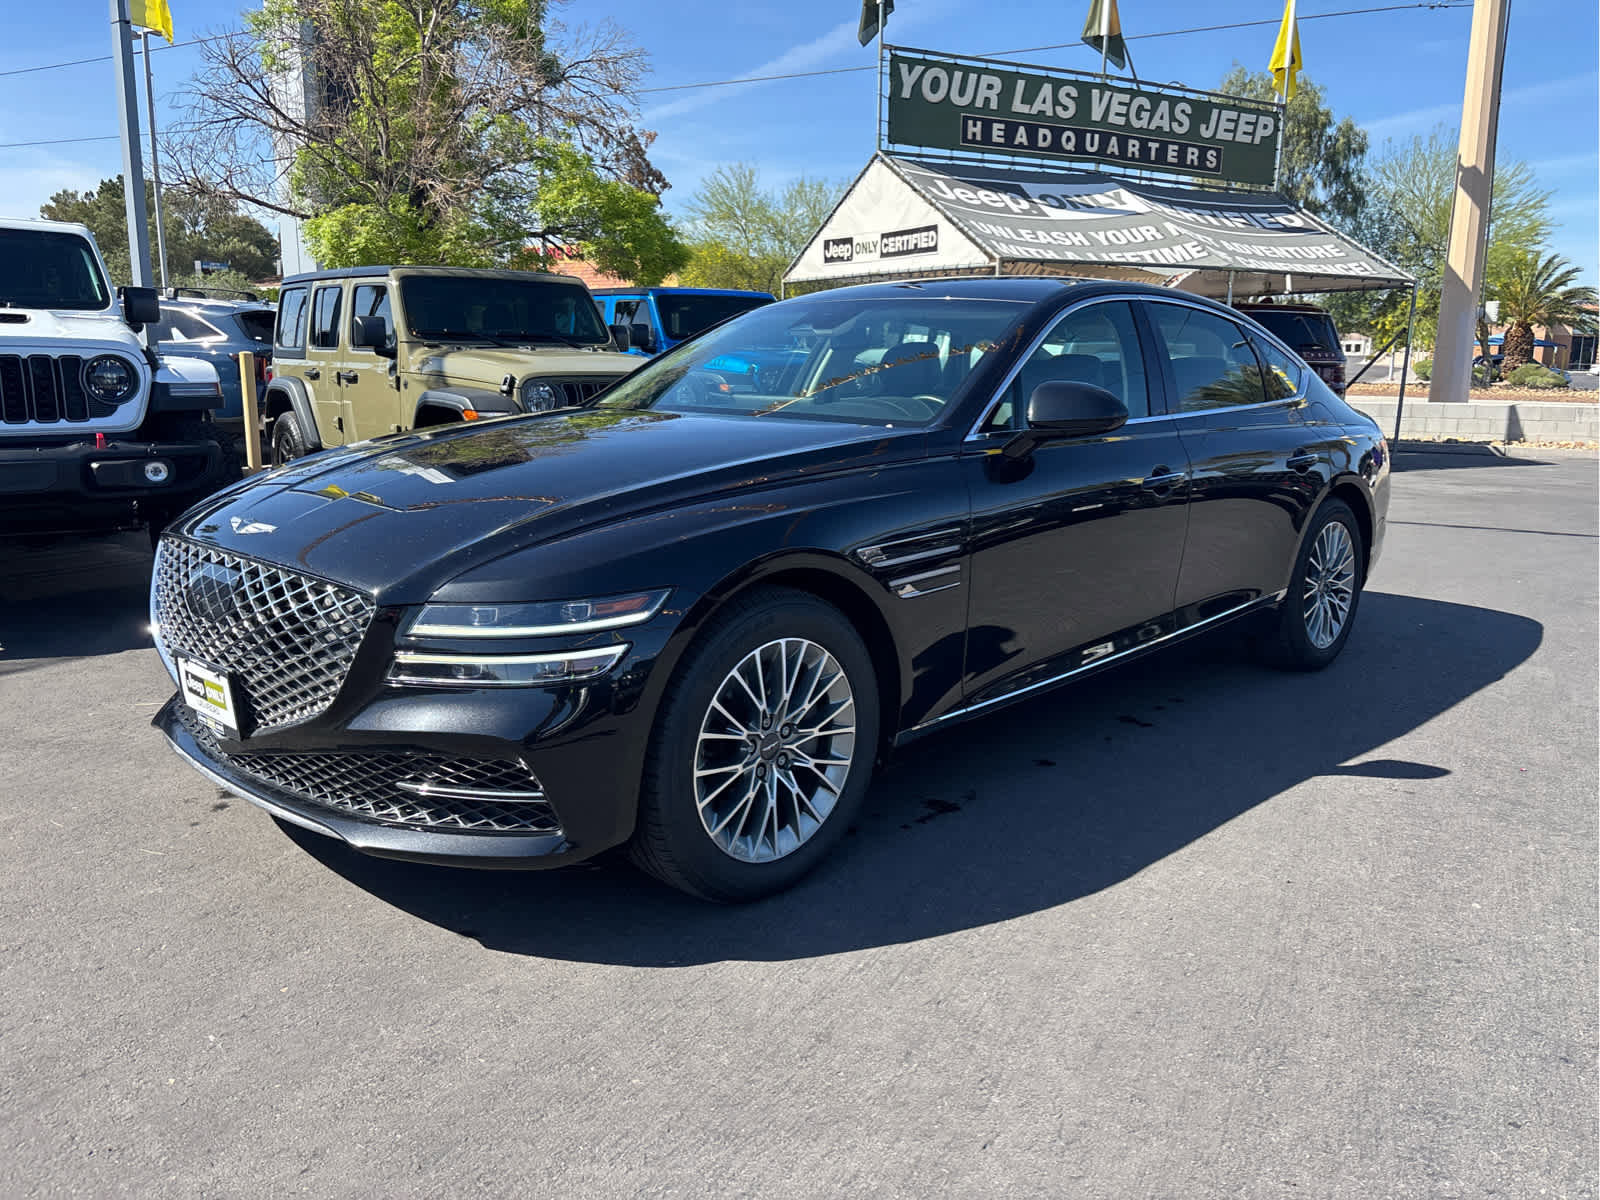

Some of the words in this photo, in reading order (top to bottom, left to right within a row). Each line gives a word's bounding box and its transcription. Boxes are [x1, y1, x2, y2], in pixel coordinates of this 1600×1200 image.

[898, 62, 1002, 110] YOUR
[1011, 79, 1079, 119] LAS
[1091, 88, 1192, 134] VEGAS
[1200, 108, 1275, 145] JEEP
[967, 119, 1218, 169] HEADQUARTERS
[928, 179, 1032, 214] Jeep
[1038, 188, 1128, 211] ONLY
[825, 240, 852, 260] Jeep
[855, 240, 878, 255] ONLY
[881, 231, 937, 253] CERTIFIED
[970, 220, 1090, 246] UNLEASH
[1088, 225, 1165, 246] YOUR
[1220, 240, 1346, 259] ADVENTURE
[990, 239, 1062, 259] WITH
[1085, 241, 1209, 263] LIFETIME
[1234, 255, 1378, 276] CONFIDENCE!
